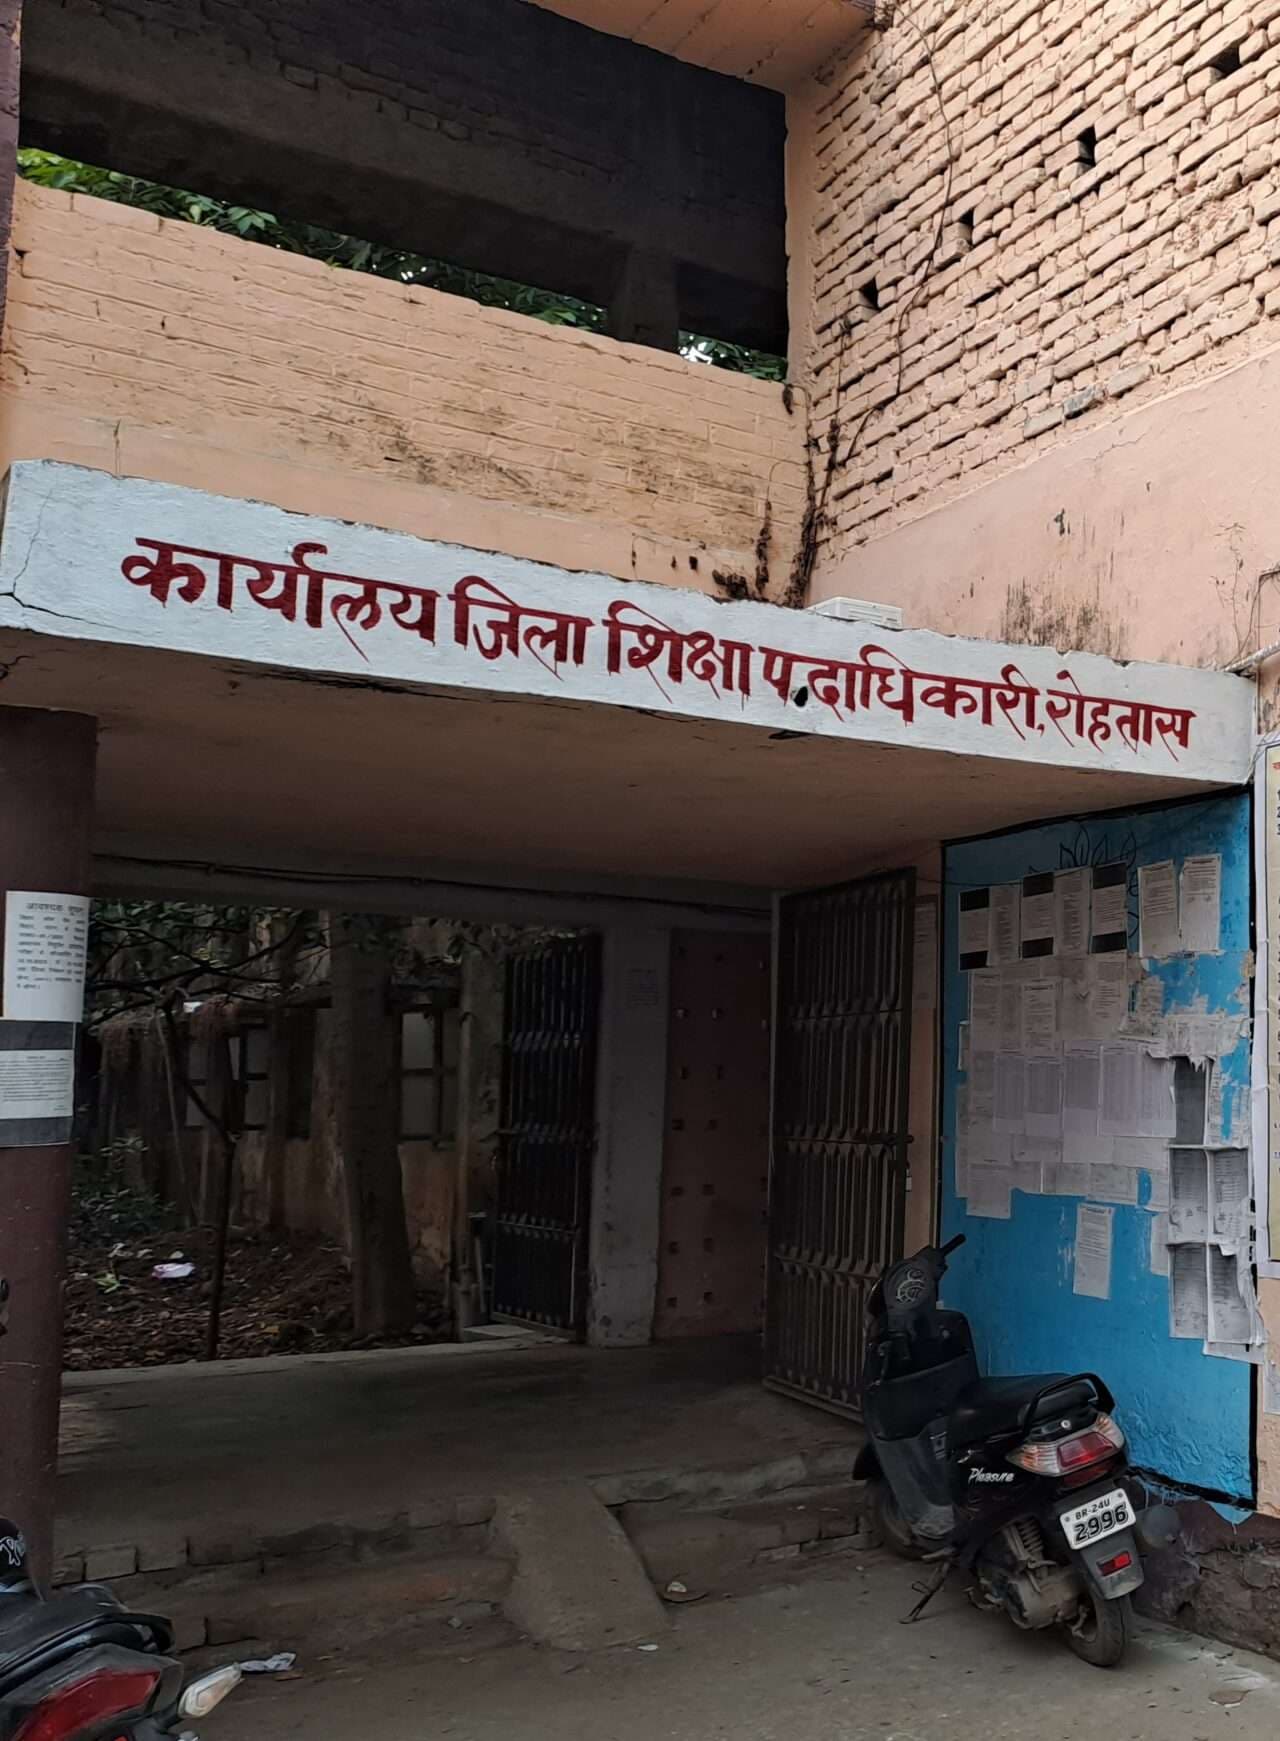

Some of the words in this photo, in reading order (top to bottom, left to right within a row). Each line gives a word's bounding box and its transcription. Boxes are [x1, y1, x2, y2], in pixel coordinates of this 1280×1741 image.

[120, 536, 441, 664] कार्यालय
[447, 574, 595, 681] जिला
[602, 600, 753, 706] शिक्षा
[1046, 668, 1197, 762] रोहतास
[967, 1466, 1016, 1485] Pleasure
[1074, 1498, 1112, 1521] BR-24U
[1074, 1503, 1129, 1545] 2996
